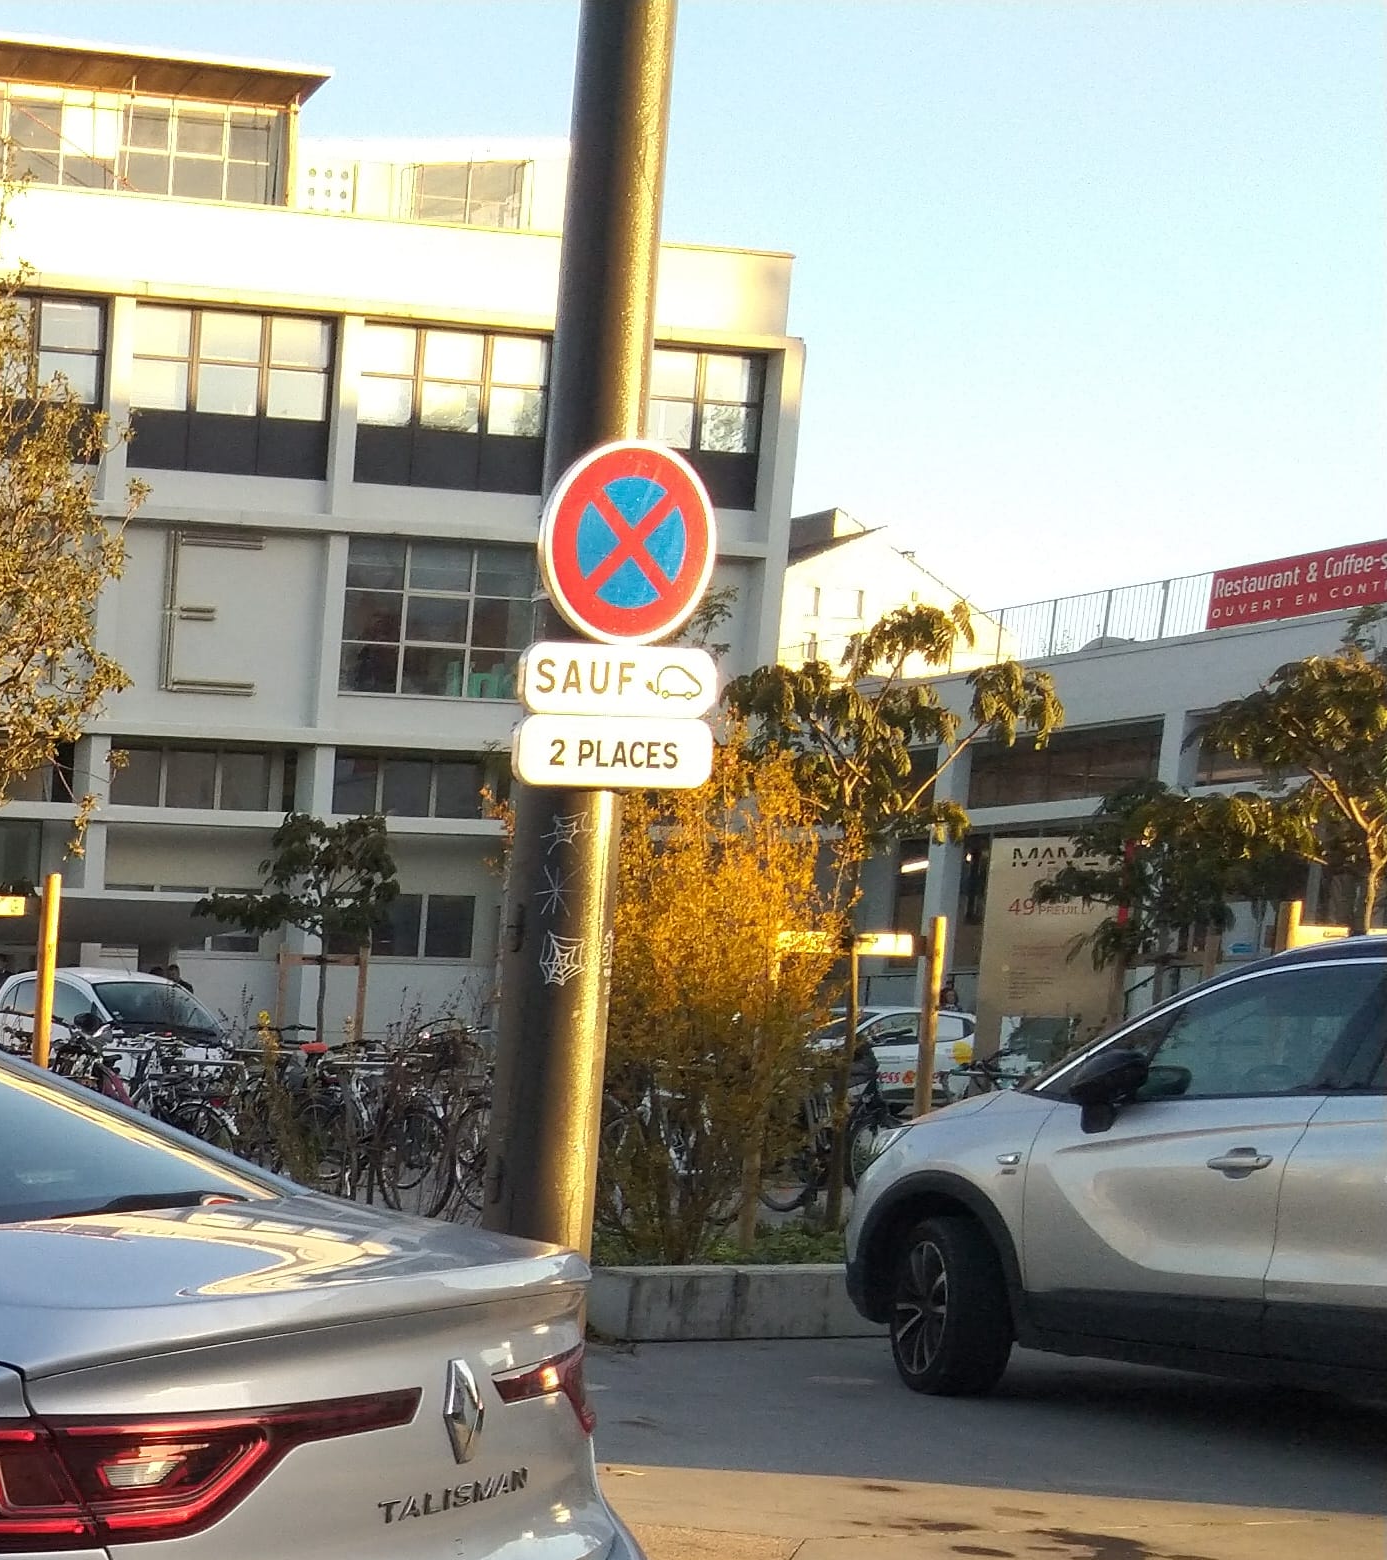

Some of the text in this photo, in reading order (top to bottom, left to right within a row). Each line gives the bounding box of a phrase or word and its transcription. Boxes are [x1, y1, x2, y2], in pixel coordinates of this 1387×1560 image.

[1214, 565, 1301, 600] Restaurant
[1306, 561, 1318, 583] &
[1211, 597, 1284, 619] OUVERT
[1295, 592, 1318, 606] EN
[535, 658, 636, 696] SAUF
[549, 739, 679, 770] 2 PLACES
[1007, 898, 1036, 916] 49
[378, 1467, 529, 1524] TALISMAN
